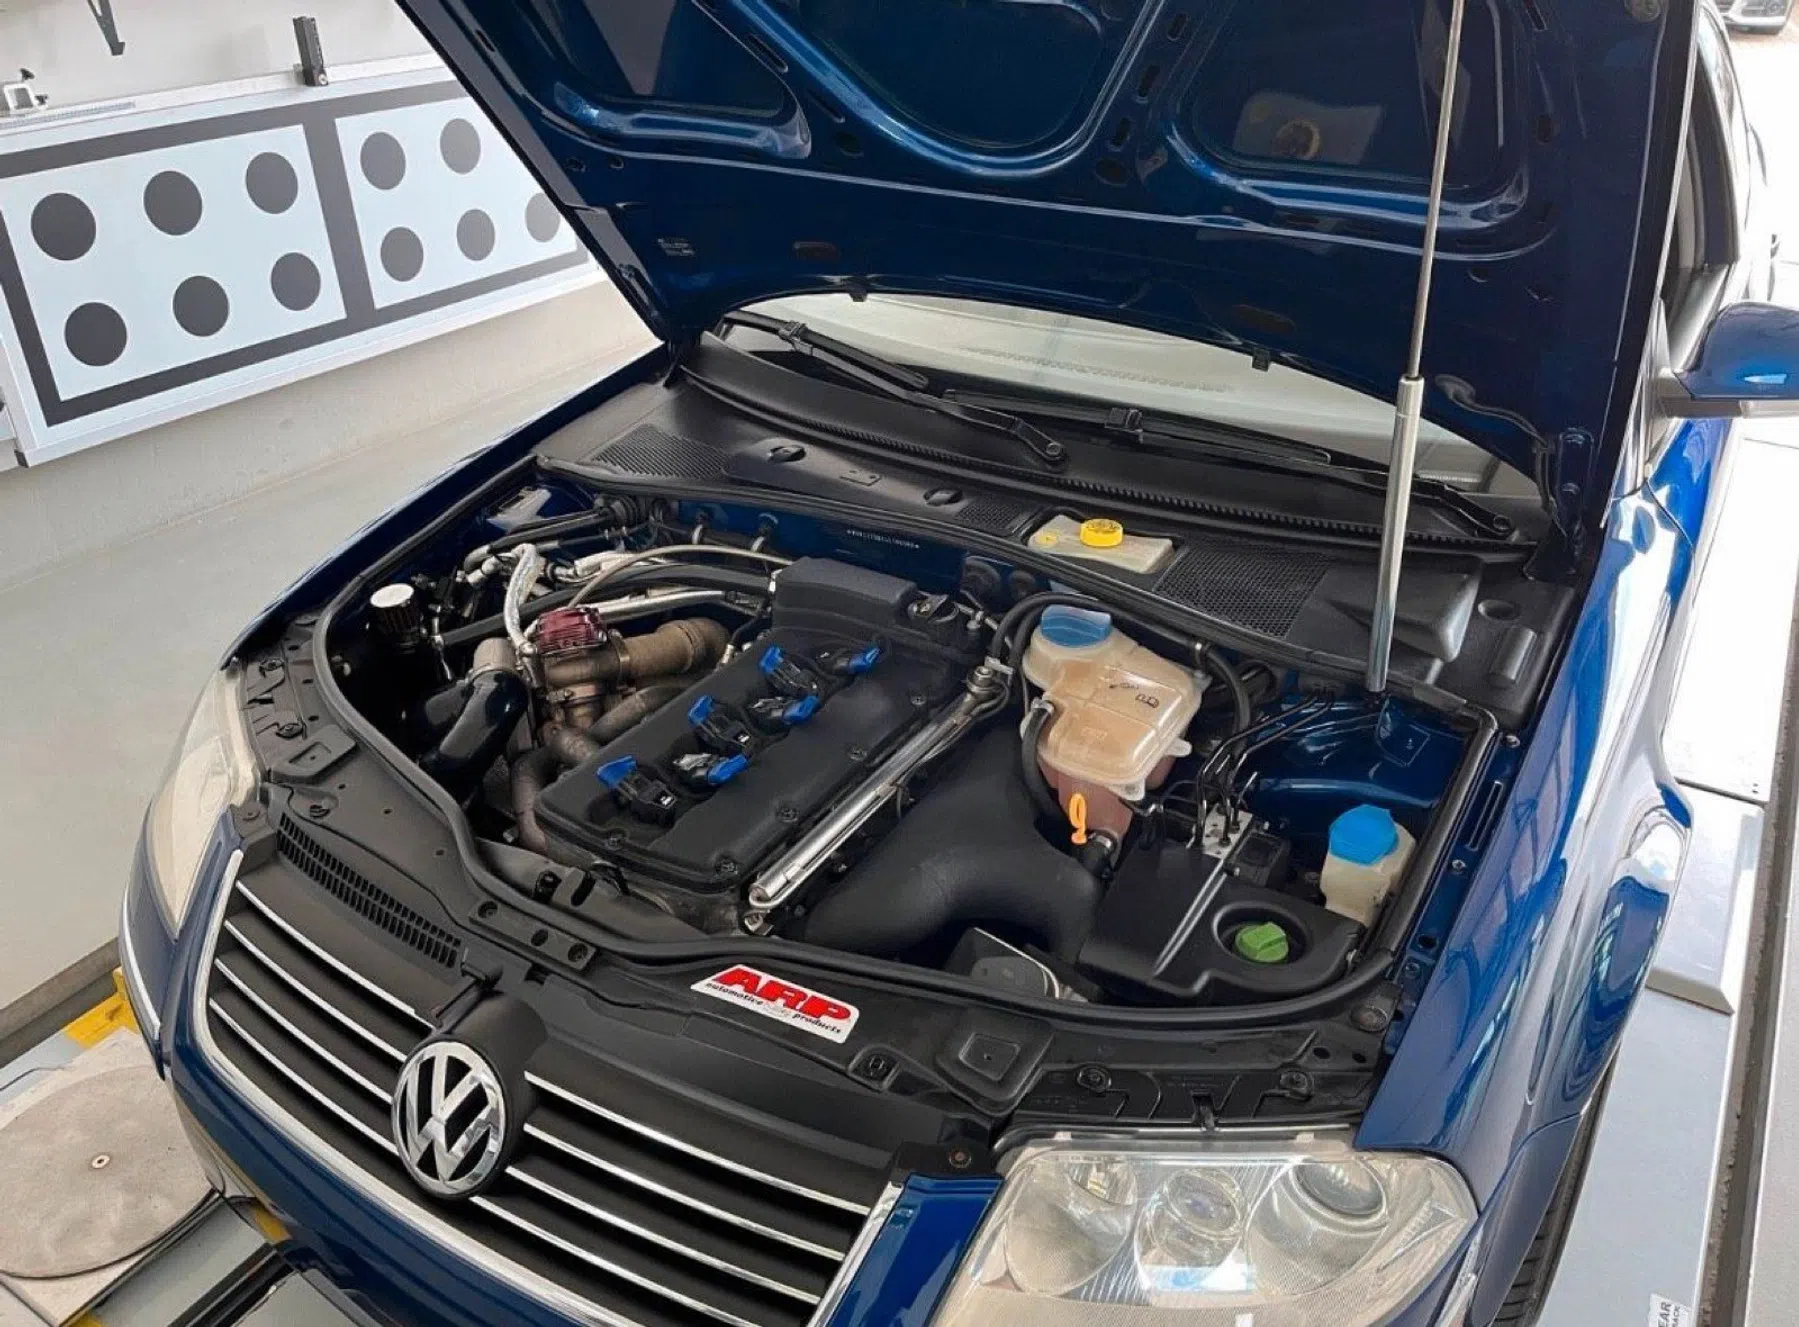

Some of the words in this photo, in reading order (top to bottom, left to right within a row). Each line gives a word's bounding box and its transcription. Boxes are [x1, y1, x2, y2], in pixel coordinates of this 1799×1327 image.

[705, 982, 763, 1006] automotive
[792, 1012, 842, 1034] products
[712, 967, 852, 1020] ARP
[399, 1047, 502, 1188] VW
